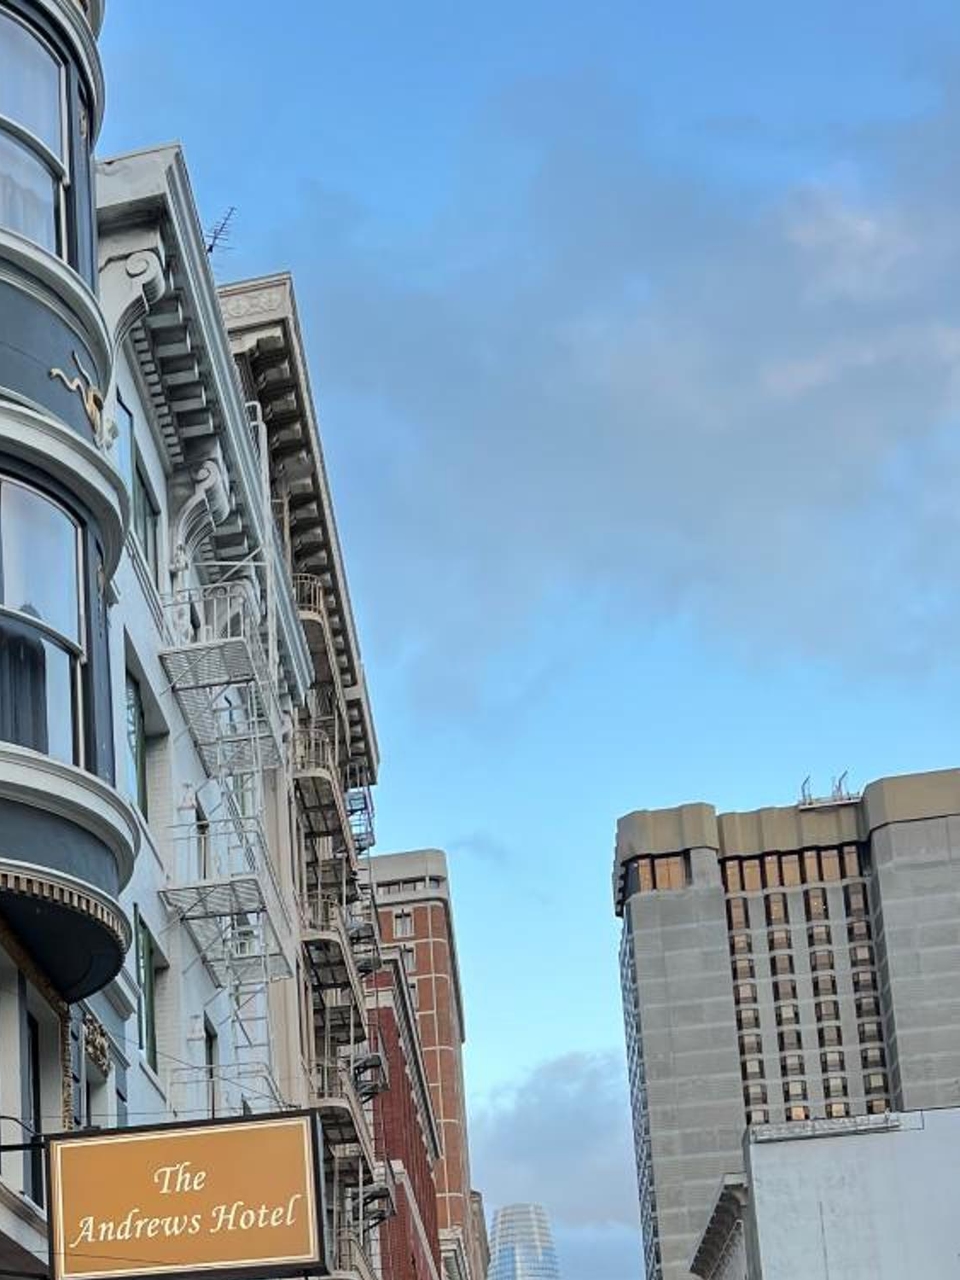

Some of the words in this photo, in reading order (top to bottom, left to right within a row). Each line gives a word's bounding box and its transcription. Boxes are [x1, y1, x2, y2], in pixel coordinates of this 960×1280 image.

[153, 1161, 206, 1194] The
[69, 1208, 201, 1248] Andrews
[210, 1194, 303, 1233] Hotel
